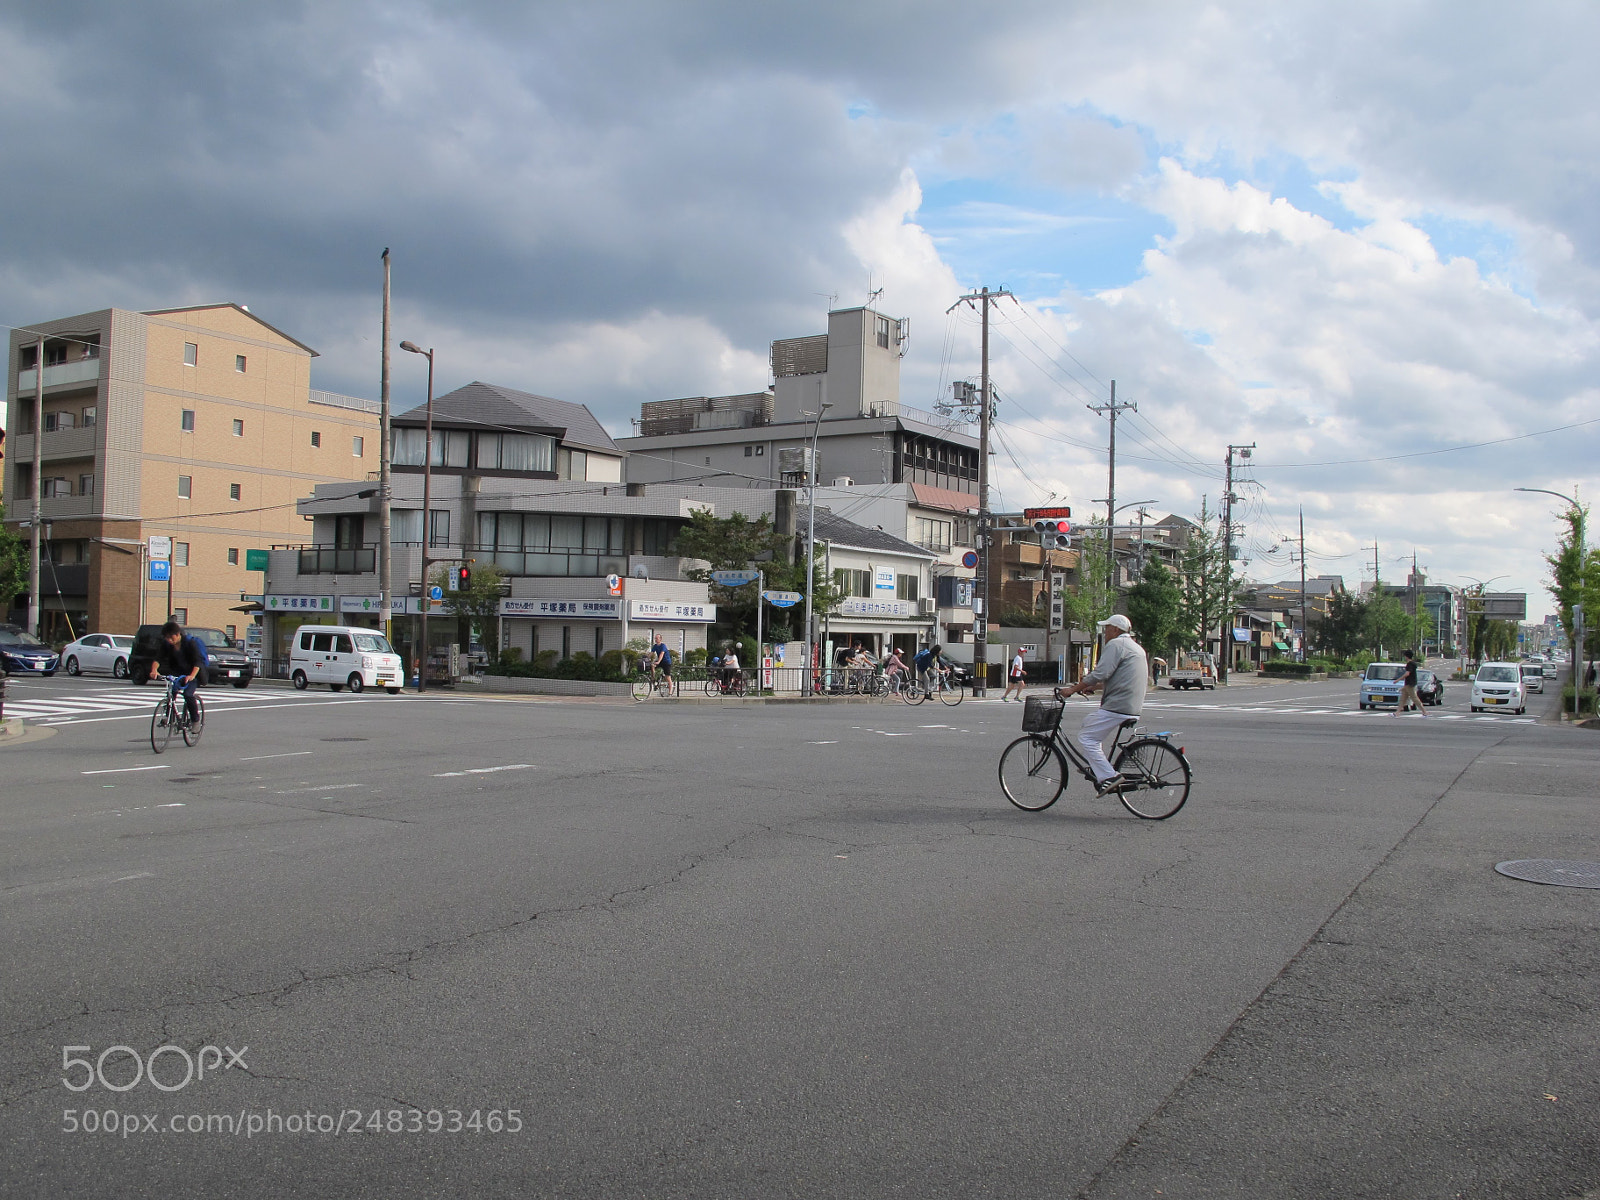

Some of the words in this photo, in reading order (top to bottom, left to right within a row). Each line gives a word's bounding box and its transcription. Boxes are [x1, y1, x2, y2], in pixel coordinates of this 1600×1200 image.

[540, 602, 576, 613] 平塚薬局
[675, 606, 704, 617] 平塚薬局
